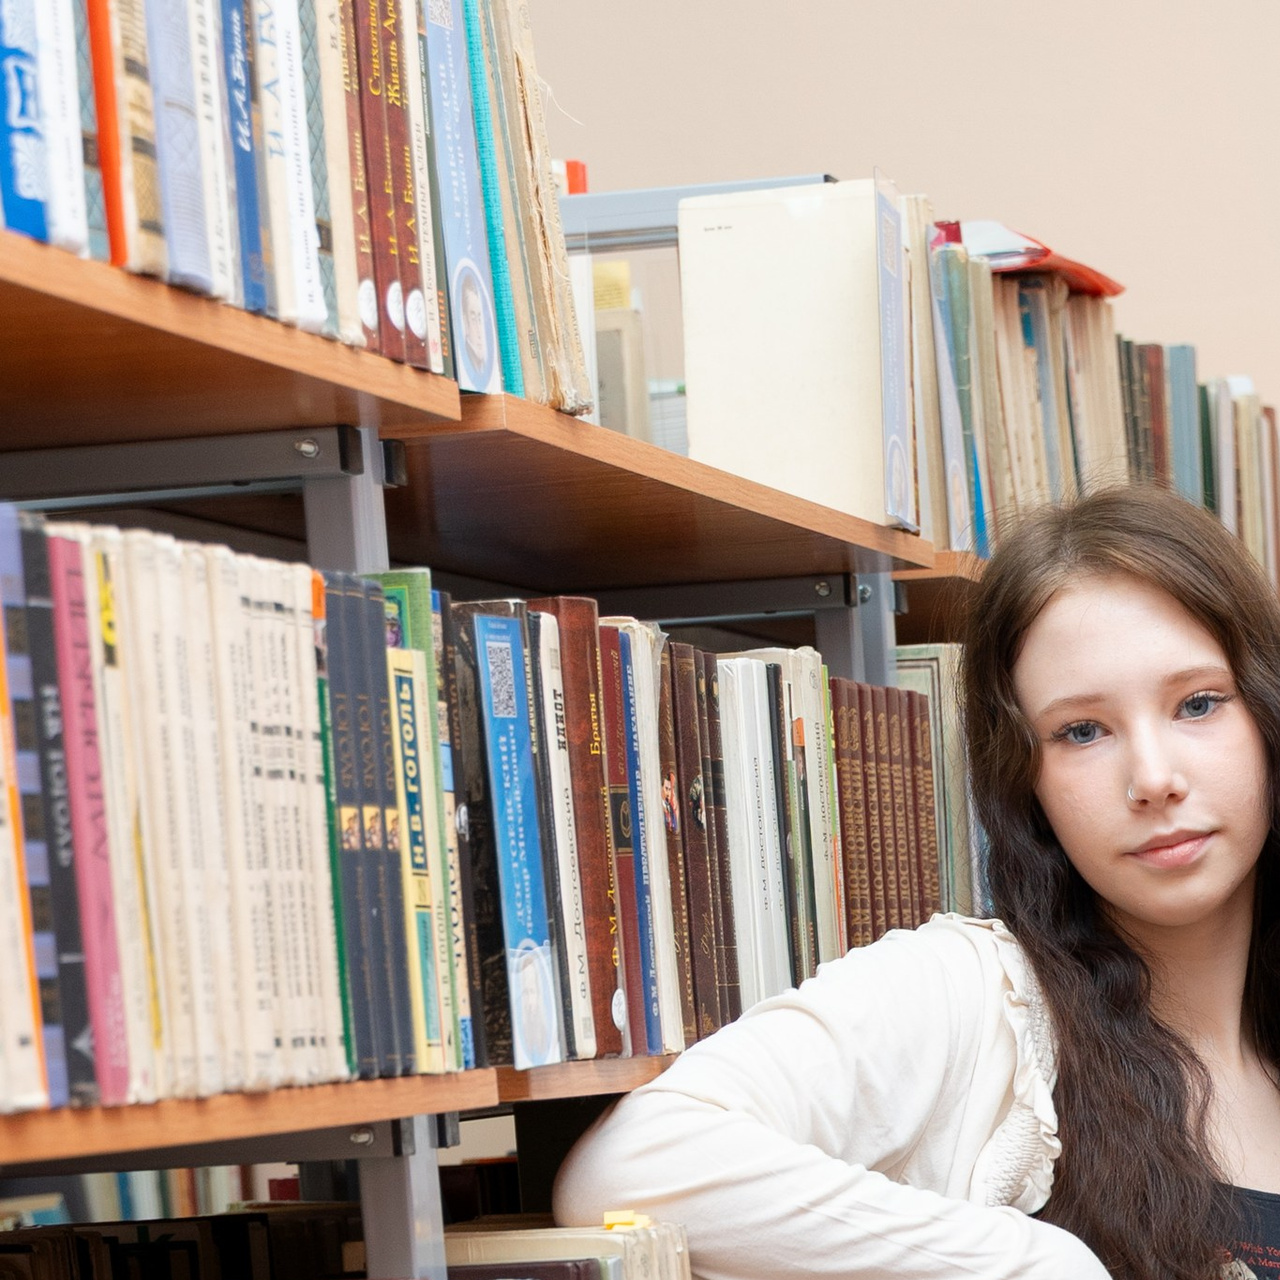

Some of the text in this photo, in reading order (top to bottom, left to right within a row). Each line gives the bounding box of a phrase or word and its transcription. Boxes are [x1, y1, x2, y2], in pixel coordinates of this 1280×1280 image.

[399, 681, 419, 794] ГОГОЛЬ
[552, 689, 567, 751] ИДИОТ
[589, 691, 602, 756] Братья
[626, 664, 640, 752] НАКАЗАНИЕ
[813, 720, 828, 823] ДОСТОЕВСКИЙ
[499, 734, 525, 926] ДОСТОЕВСКИЙ
[563, 786, 583, 942] Достоевский
[600, 785, 616, 905] Достоевский
[752, 756, 767, 871] ДОСТОЕВСКИЙ
[837, 756, 861, 901] ДОСТОЕВСКИЙ
[848, 758, 871, 900] ДОСТОЕВСКИЙ
[863, 759, 886, 901] ДОСТОЕВСКИЙ
[876, 760, 897, 901] ДОСТОЕВСКИЙ
[890, 762, 910, 900] ДОСТОЕВСКИЙ
[676, 852, 694, 1009] ДОСТОЕВСКИЙ
